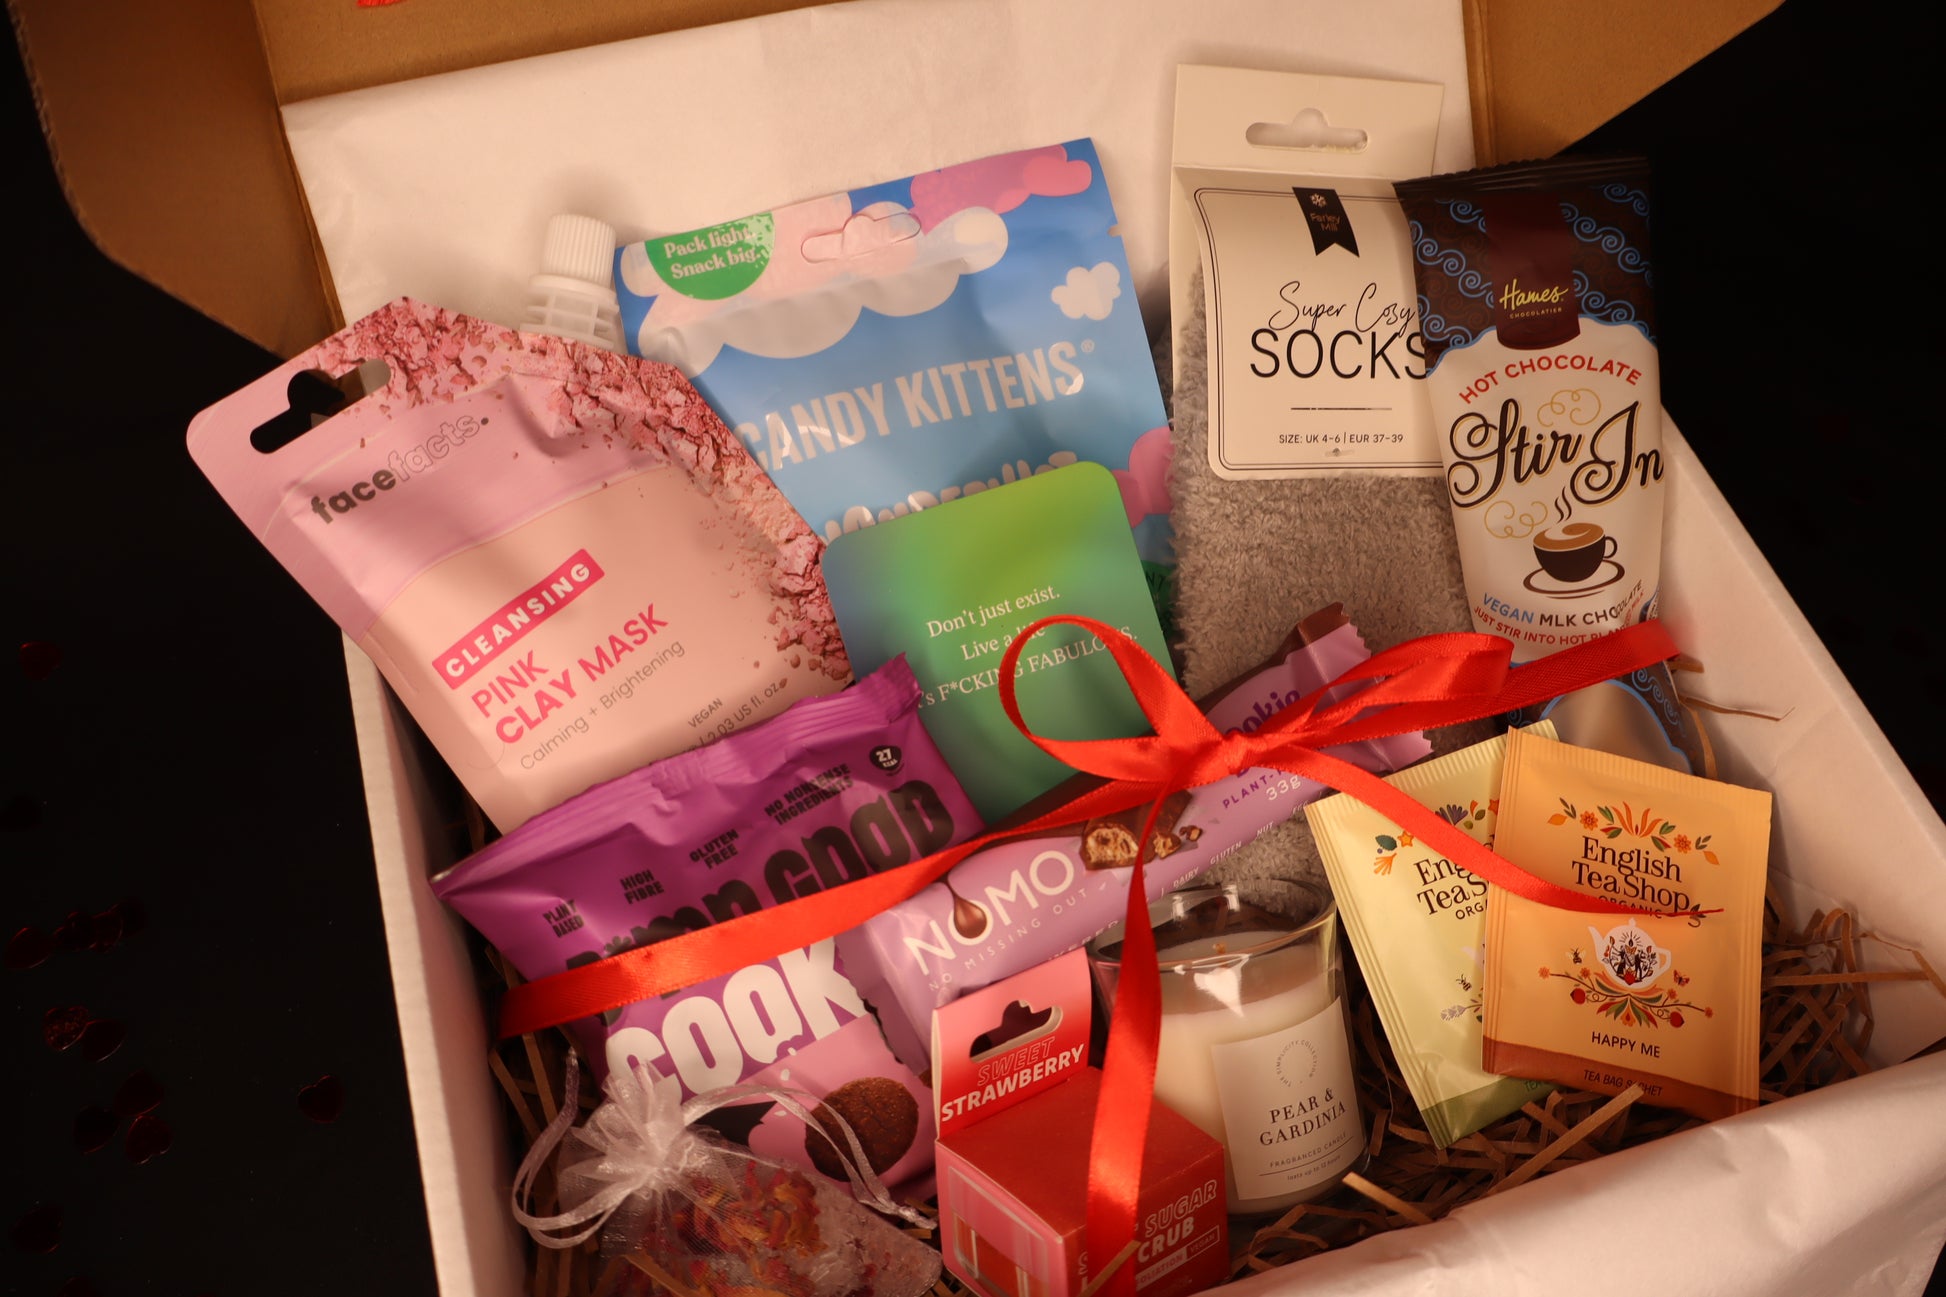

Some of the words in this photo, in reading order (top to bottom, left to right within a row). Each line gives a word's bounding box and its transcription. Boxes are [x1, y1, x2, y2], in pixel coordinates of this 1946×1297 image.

[664, 236, 708, 258] Pack
[671, 253, 727, 279] Snack
[726, 246, 761, 264] big.
[1268, 280, 1347, 333] Super
[1500, 278, 1568, 311] Hames
[1509, 306, 1562, 320] CHOCOLATIER
[1250, 328, 1427, 380] SOCKS
[1459, 370, 1500, 404] HOT
[1504, 354, 1643, 386] CHOCOLATE
[736, 382, 892, 471] CANDY
[1279, 434, 1303, 444] SIZE:
[1305, 434, 1319, 444] UK
[1321, 434, 1341, 444] 4-6
[1349, 434, 1370, 444] EUR
[1372, 434, 1404, 444] 37-39
[1448, 398, 1584, 508] Stir
[1569, 400, 1665, 505] In
[445, 563, 591, 678] CLEANSING
[926, 610, 977, 638] Don't
[979, 603, 1012, 627] just
[1015, 585, 1061, 610] exist.
[1474, 607, 1496, 626] JUST
[1495, 621, 1521, 639] STIR
[1523, 631, 1556, 645] INTO
[1559, 634, 1587, 645] HOT
[1484, 593, 1534, 624] VEGAN
[961, 639, 1000, 661] Live
[1027, 626, 1138, 673] FABULOS.
[471, 650, 549, 718] PINK
[495, 669, 577, 744] CLAY
[577, 603, 669, 682] MASK
[520, 715, 591, 770] Calming
[600, 640, 686, 711] Brightening
[688, 698, 723, 728] VEGAN
[734, 704, 752, 722] US
[875, 748, 892, 762] 27
[774, 776, 854, 825] INGREDIENTS
[1266, 775, 1302, 801] 33g
[764, 799, 784, 817] NO
[689, 829, 740, 863] GLUTEN
[703, 844, 738, 870] FREE
[1173, 867, 1199, 888] DAIRY
[1210, 841, 1242, 865] GLUTEN
[1257, 821, 1274, 837] NUT
[1582, 835, 1682, 883] English
[619, 869, 655, 891] HIGH
[624, 880, 664, 905] FIBRE
[542, 899, 577, 925] PLANT
[552, 914, 585, 938] BASED
[902, 850, 1075, 977] NOMO
[928, 971, 953, 992] NO
[964, 918, 1042, 971] MISSING
[1052, 888, 1087, 914] OUT
[977, 1036, 1056, 1086] SWEET
[1591, 1031, 1637, 1052] HAPPY
[1640, 1042, 1661, 1059] ME
[941, 1043, 1085, 1122] STRAWBERRY
[1584, 1069, 1601, 1082] TEA
[1602, 1074, 1624, 1089] BAG
[1625, 1079, 1663, 1097] SCHET
[1259, 1100, 1346, 1146] GARDINIA
[1270, 1095, 1320, 1124] PEAR
[1323, 1087, 1334, 1103] &
[1270, 1147, 1322, 1168] FRAGRANCED
[1145, 1179, 1217, 1238] SUGAR
[1138, 1216, 1195, 1263] CRUB
